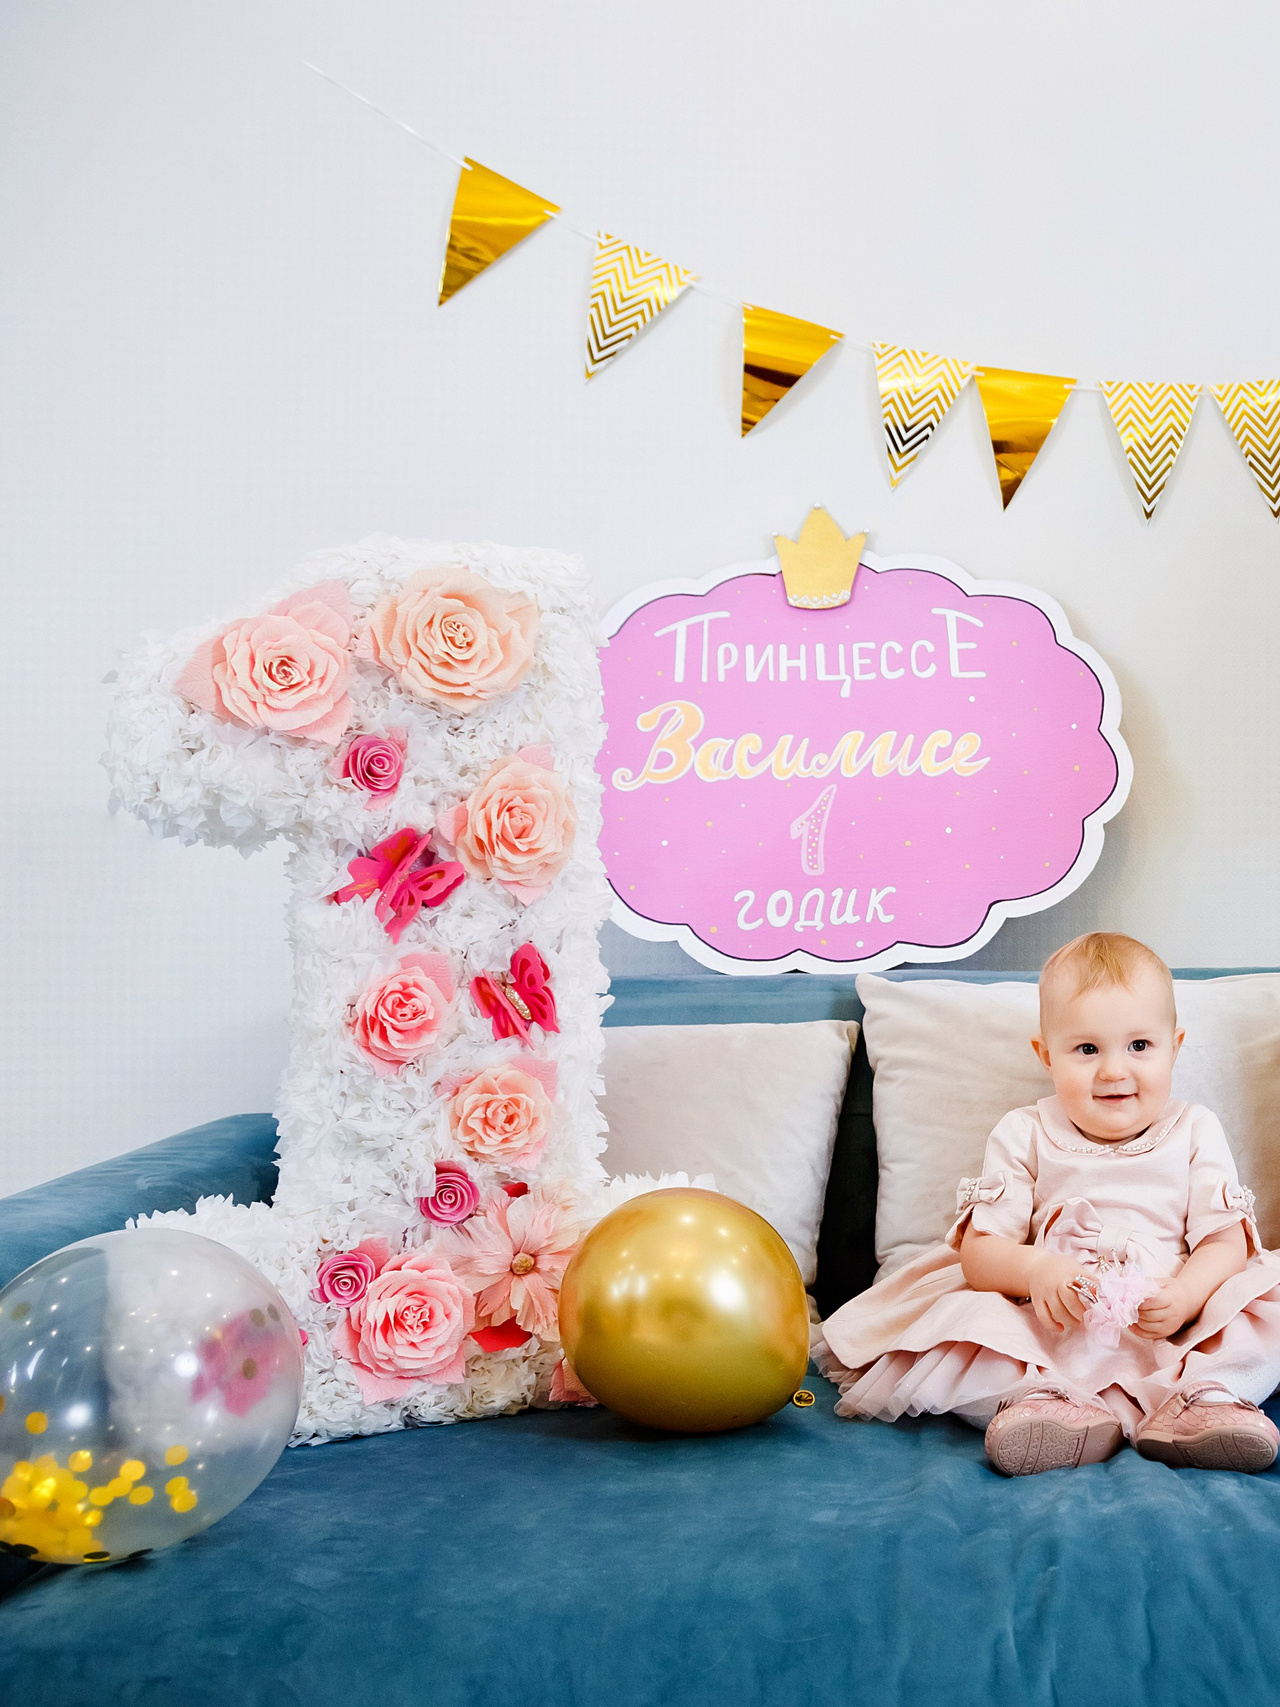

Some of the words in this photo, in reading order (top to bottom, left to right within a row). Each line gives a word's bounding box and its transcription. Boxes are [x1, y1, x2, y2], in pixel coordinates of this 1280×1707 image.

[654, 610, 987, 698] ПРИНЦЕССЕ
[611, 700, 991, 792] Василисе
[790, 783, 837, 876] 1
[733, 886, 897, 932] годик
